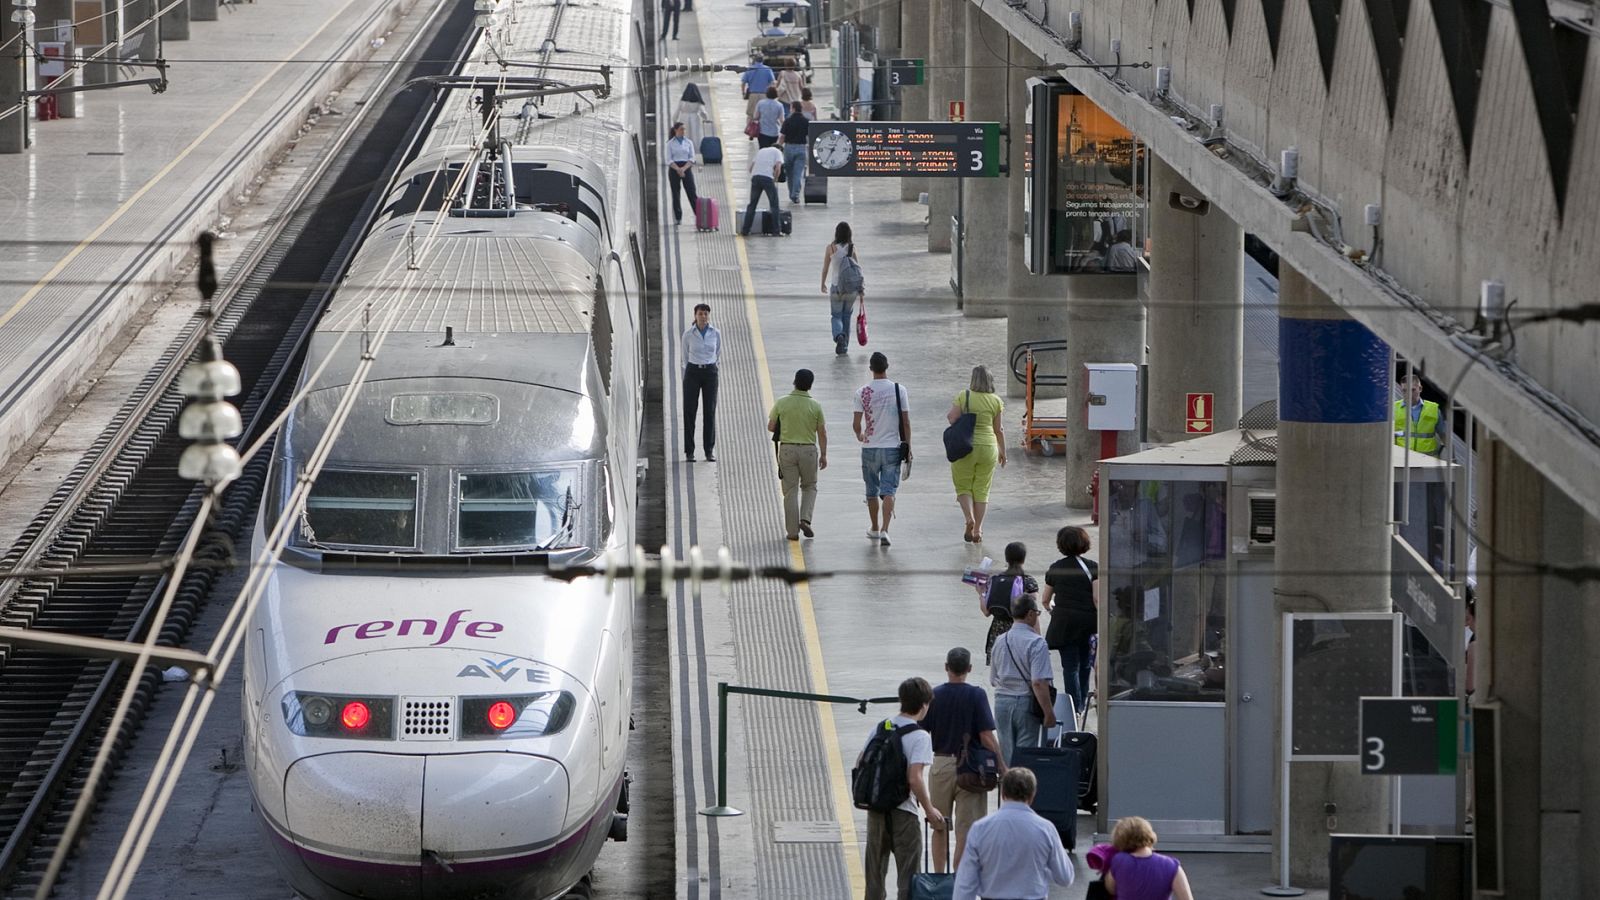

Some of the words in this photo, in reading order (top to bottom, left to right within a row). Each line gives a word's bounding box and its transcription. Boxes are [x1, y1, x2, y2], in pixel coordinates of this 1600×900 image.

[892, 72, 900, 84] 3
[970, 150, 983, 170] 3
[1066, 200, 1098, 210] Seguimos
[1100, 201, 1134, 210] trabajando
[1066, 210, 1087, 218] pronto
[1088, 210, 1108, 219] tengas
[324, 608, 504, 646] renfe
[456, 661, 551, 684] AVE
[1366, 736, 1385, 770] 3
